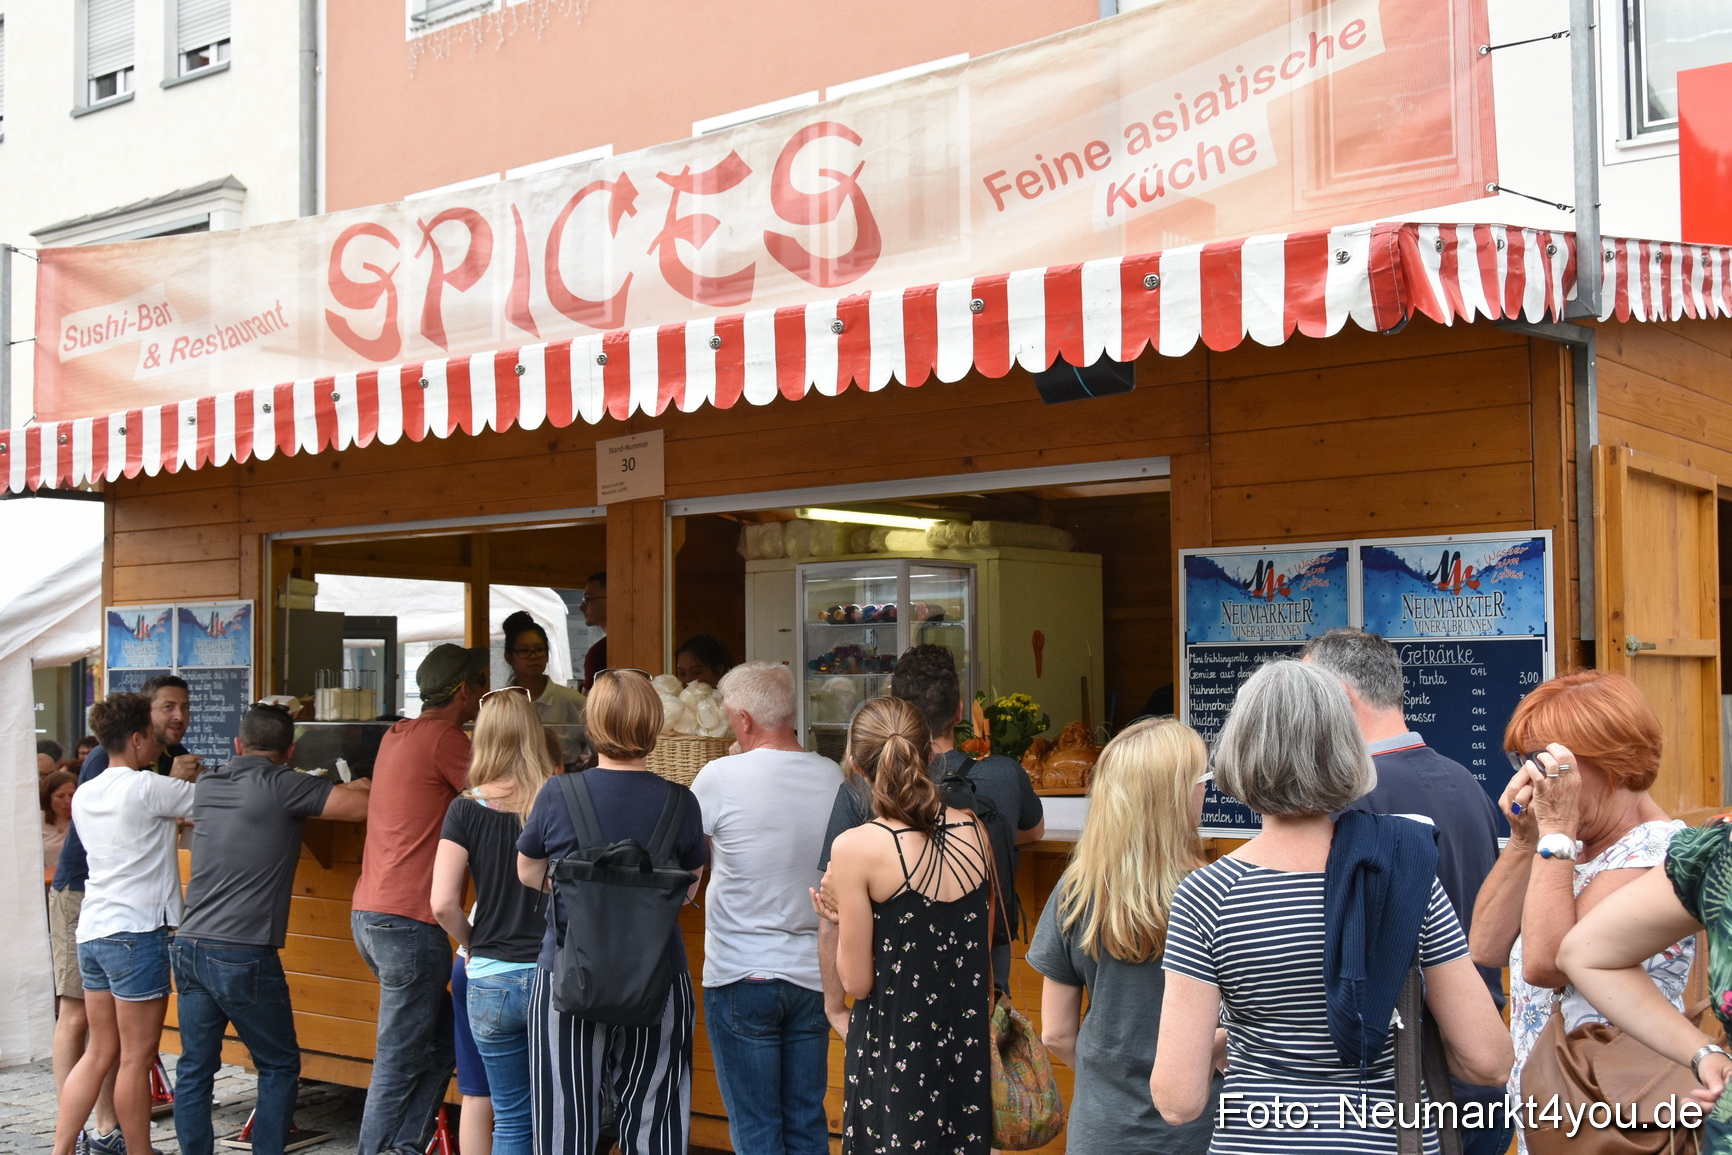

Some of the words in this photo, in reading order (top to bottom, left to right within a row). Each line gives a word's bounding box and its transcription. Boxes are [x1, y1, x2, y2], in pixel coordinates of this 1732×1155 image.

[982, 139, 1112, 212] Feine
[1124, 17, 1368, 157] asiatische
[1105, 132, 1258, 217] Küche
[325, 121, 882, 362] SPICES
[62, 300, 174, 352] Sushi-Bar
[142, 343, 161, 370] &
[169, 298, 290, 368] Restaurant
[608, 441, 649, 454] Stand-Nummer
[621, 457, 636, 472] 30
[1484, 546, 1529, 565] Wasser
[1231, 625, 1303, 638] MINERALBRUNNEN
[1414, 619, 1493, 633] MINERALBRUNNEN
[1399, 644, 1475, 665] Getränke
[1220, 670, 1235, 679] aus
[1419, 669, 1447, 685] Fanta
[1519, 671, 1539, 685] 3,00
[1235, 811, 1246, 823] in
